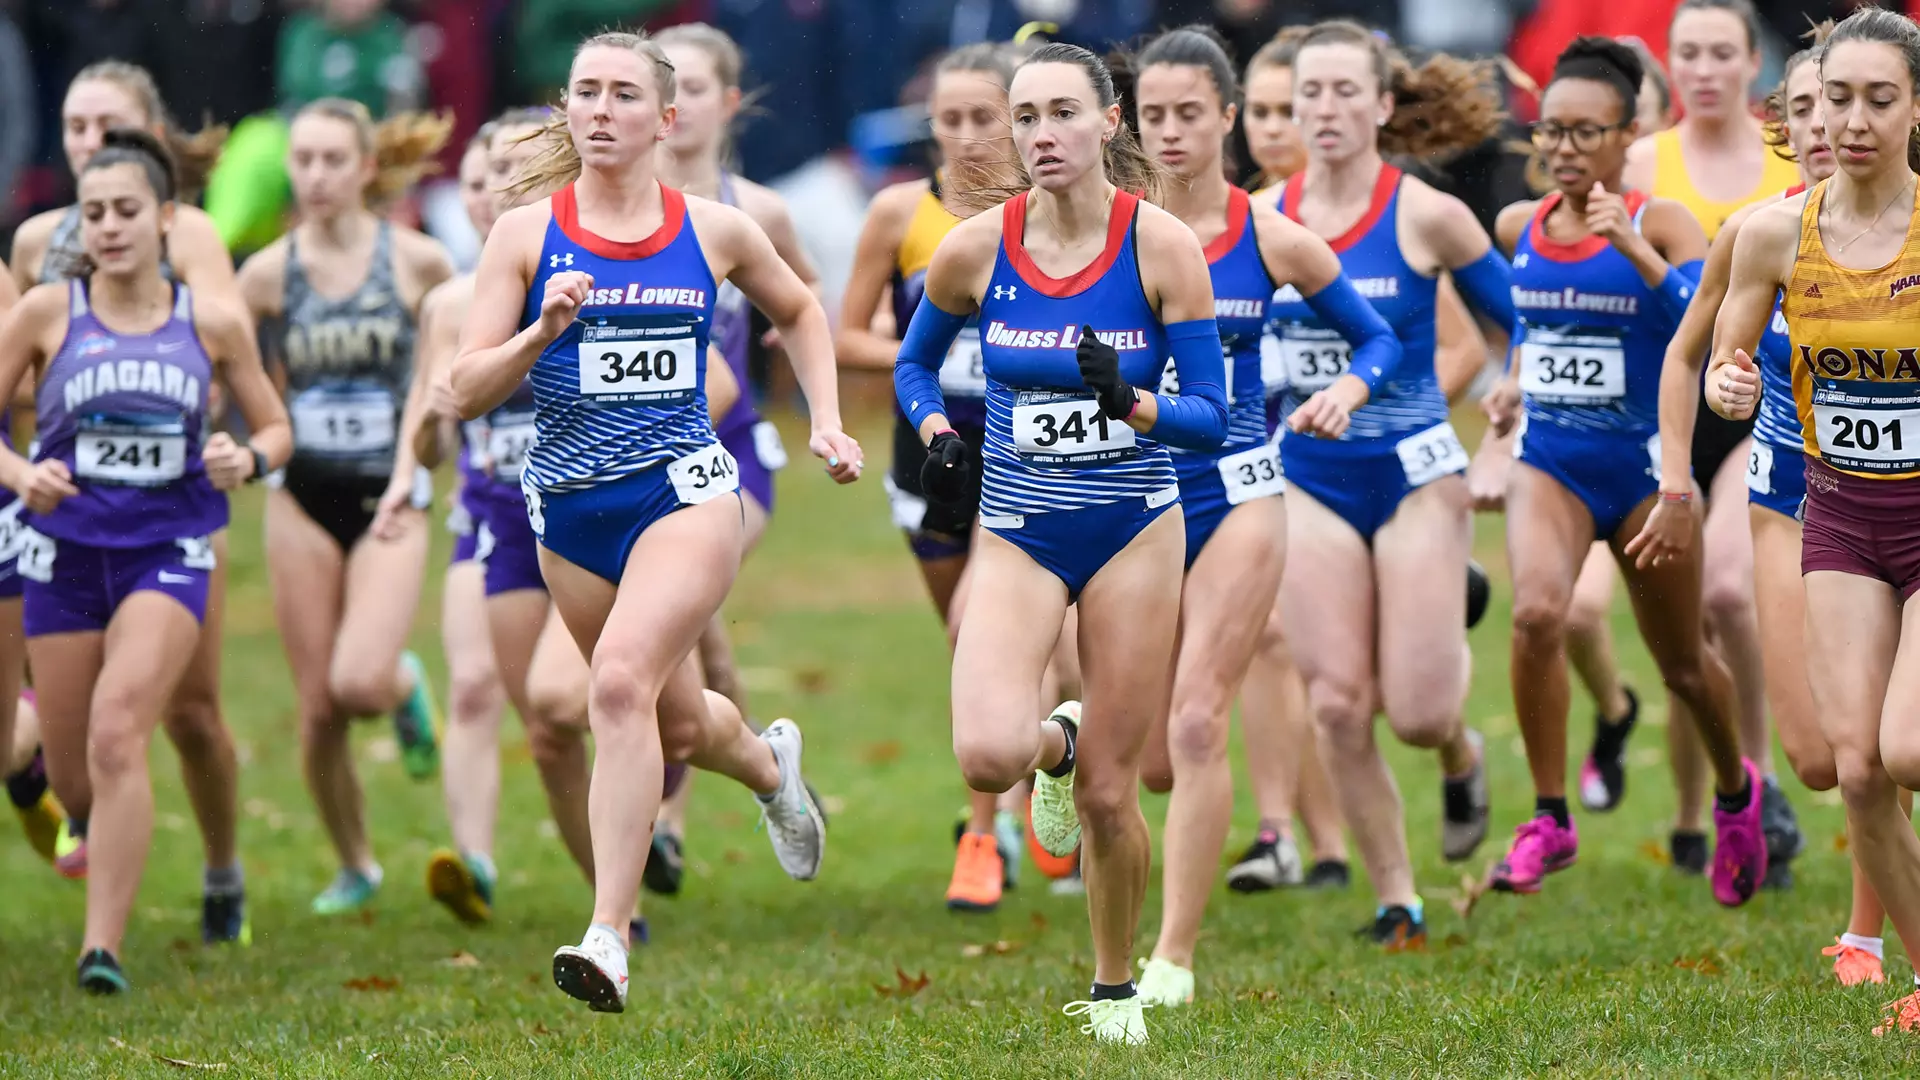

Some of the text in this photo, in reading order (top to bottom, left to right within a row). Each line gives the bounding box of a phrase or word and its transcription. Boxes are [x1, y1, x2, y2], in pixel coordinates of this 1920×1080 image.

[581, 282, 707, 309] ASS LOWELL
[1214, 299, 1264, 318] WELL
[985, 320, 1148, 350] UMASS LWELL
[600, 350, 677, 383] 340
[1299, 350, 1353, 376] 33
[1539, 356, 1605, 386] 342
[1797, 344, 1920, 380] IONA
[64, 360, 199, 413] NIAGARA
[1828, 393, 1846, 402] CROSS
[1846, 395, 1871, 404] COUNTRY
[1033, 409, 1109, 447] 341
[1831, 415, 1902, 451] 201
[96, 439, 162, 467] 241
[688, 453, 733, 489] 340
